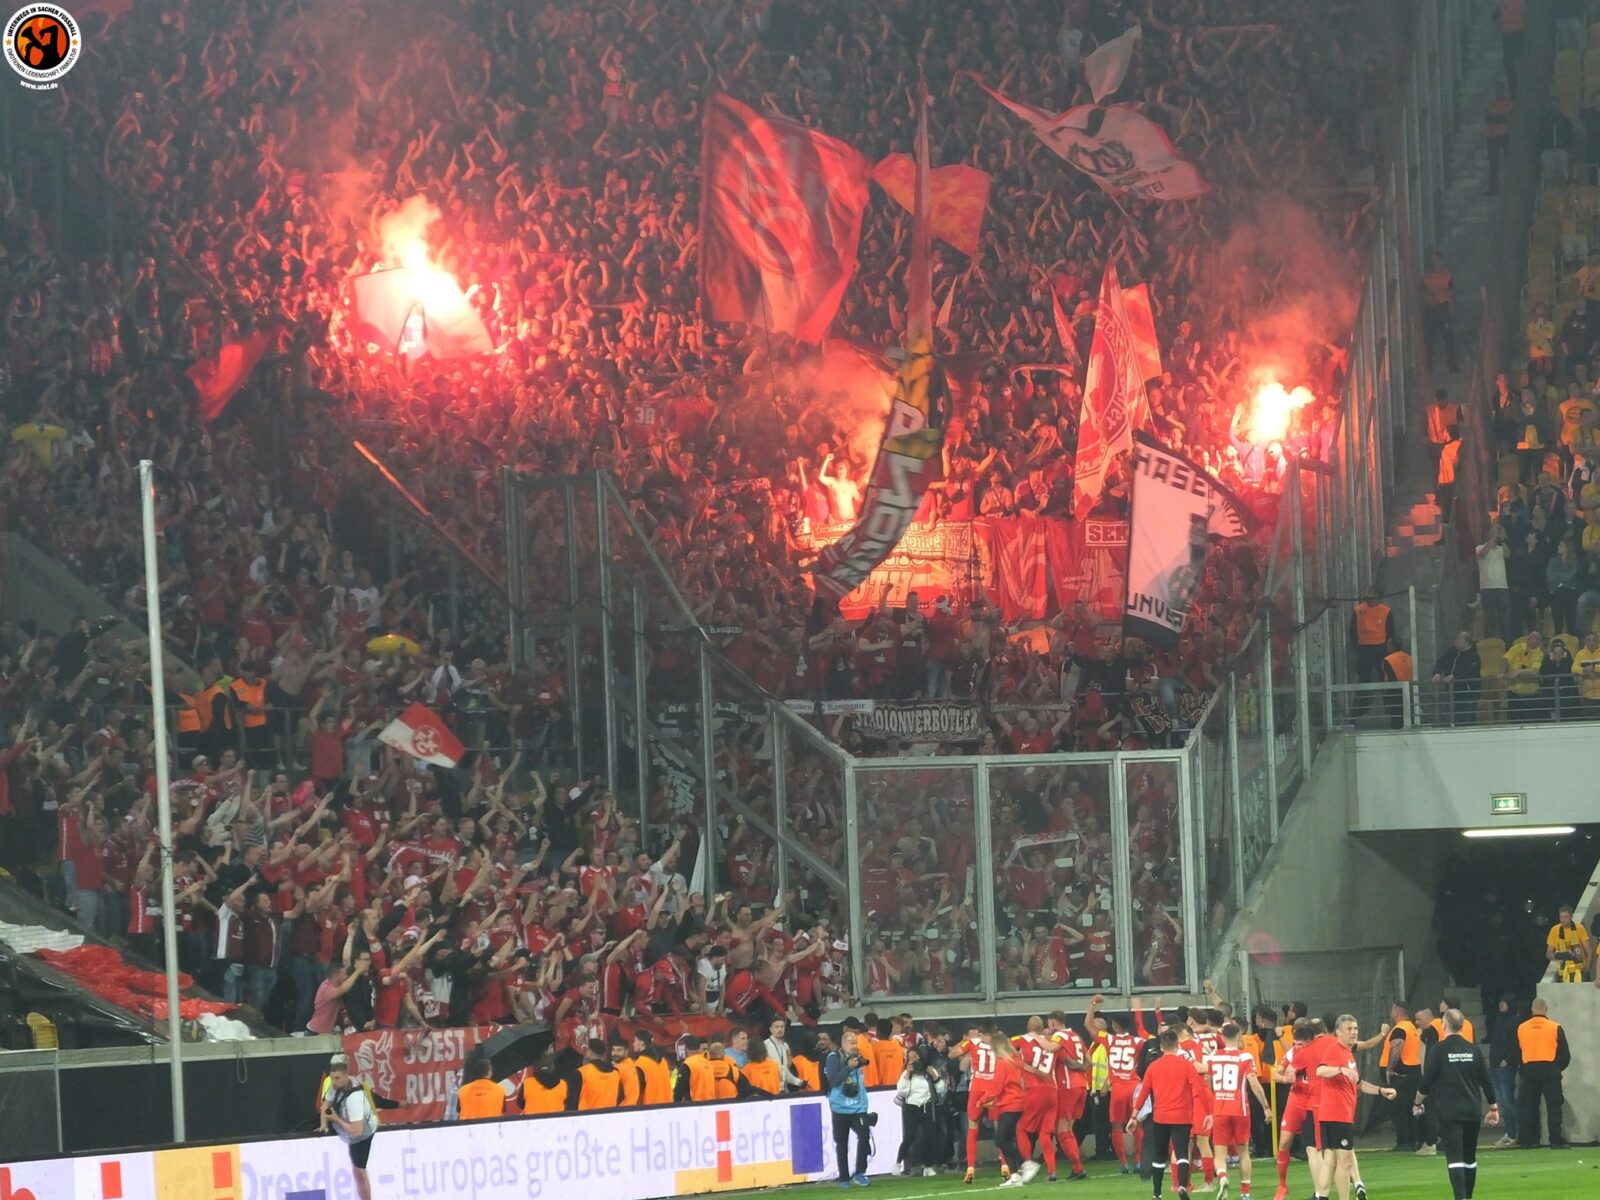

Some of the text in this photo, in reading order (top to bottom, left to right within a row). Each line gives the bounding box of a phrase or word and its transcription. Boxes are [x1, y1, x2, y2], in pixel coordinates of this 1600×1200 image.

[977, 1049, 996, 1073] 11
[1031, 1046, 1054, 1074] 13
[1109, 1046, 1135, 1070] 25
[1212, 1063, 1239, 1091] 28
[402, 1146, 518, 1200] Europas
[526, 1129, 621, 1198] größte
